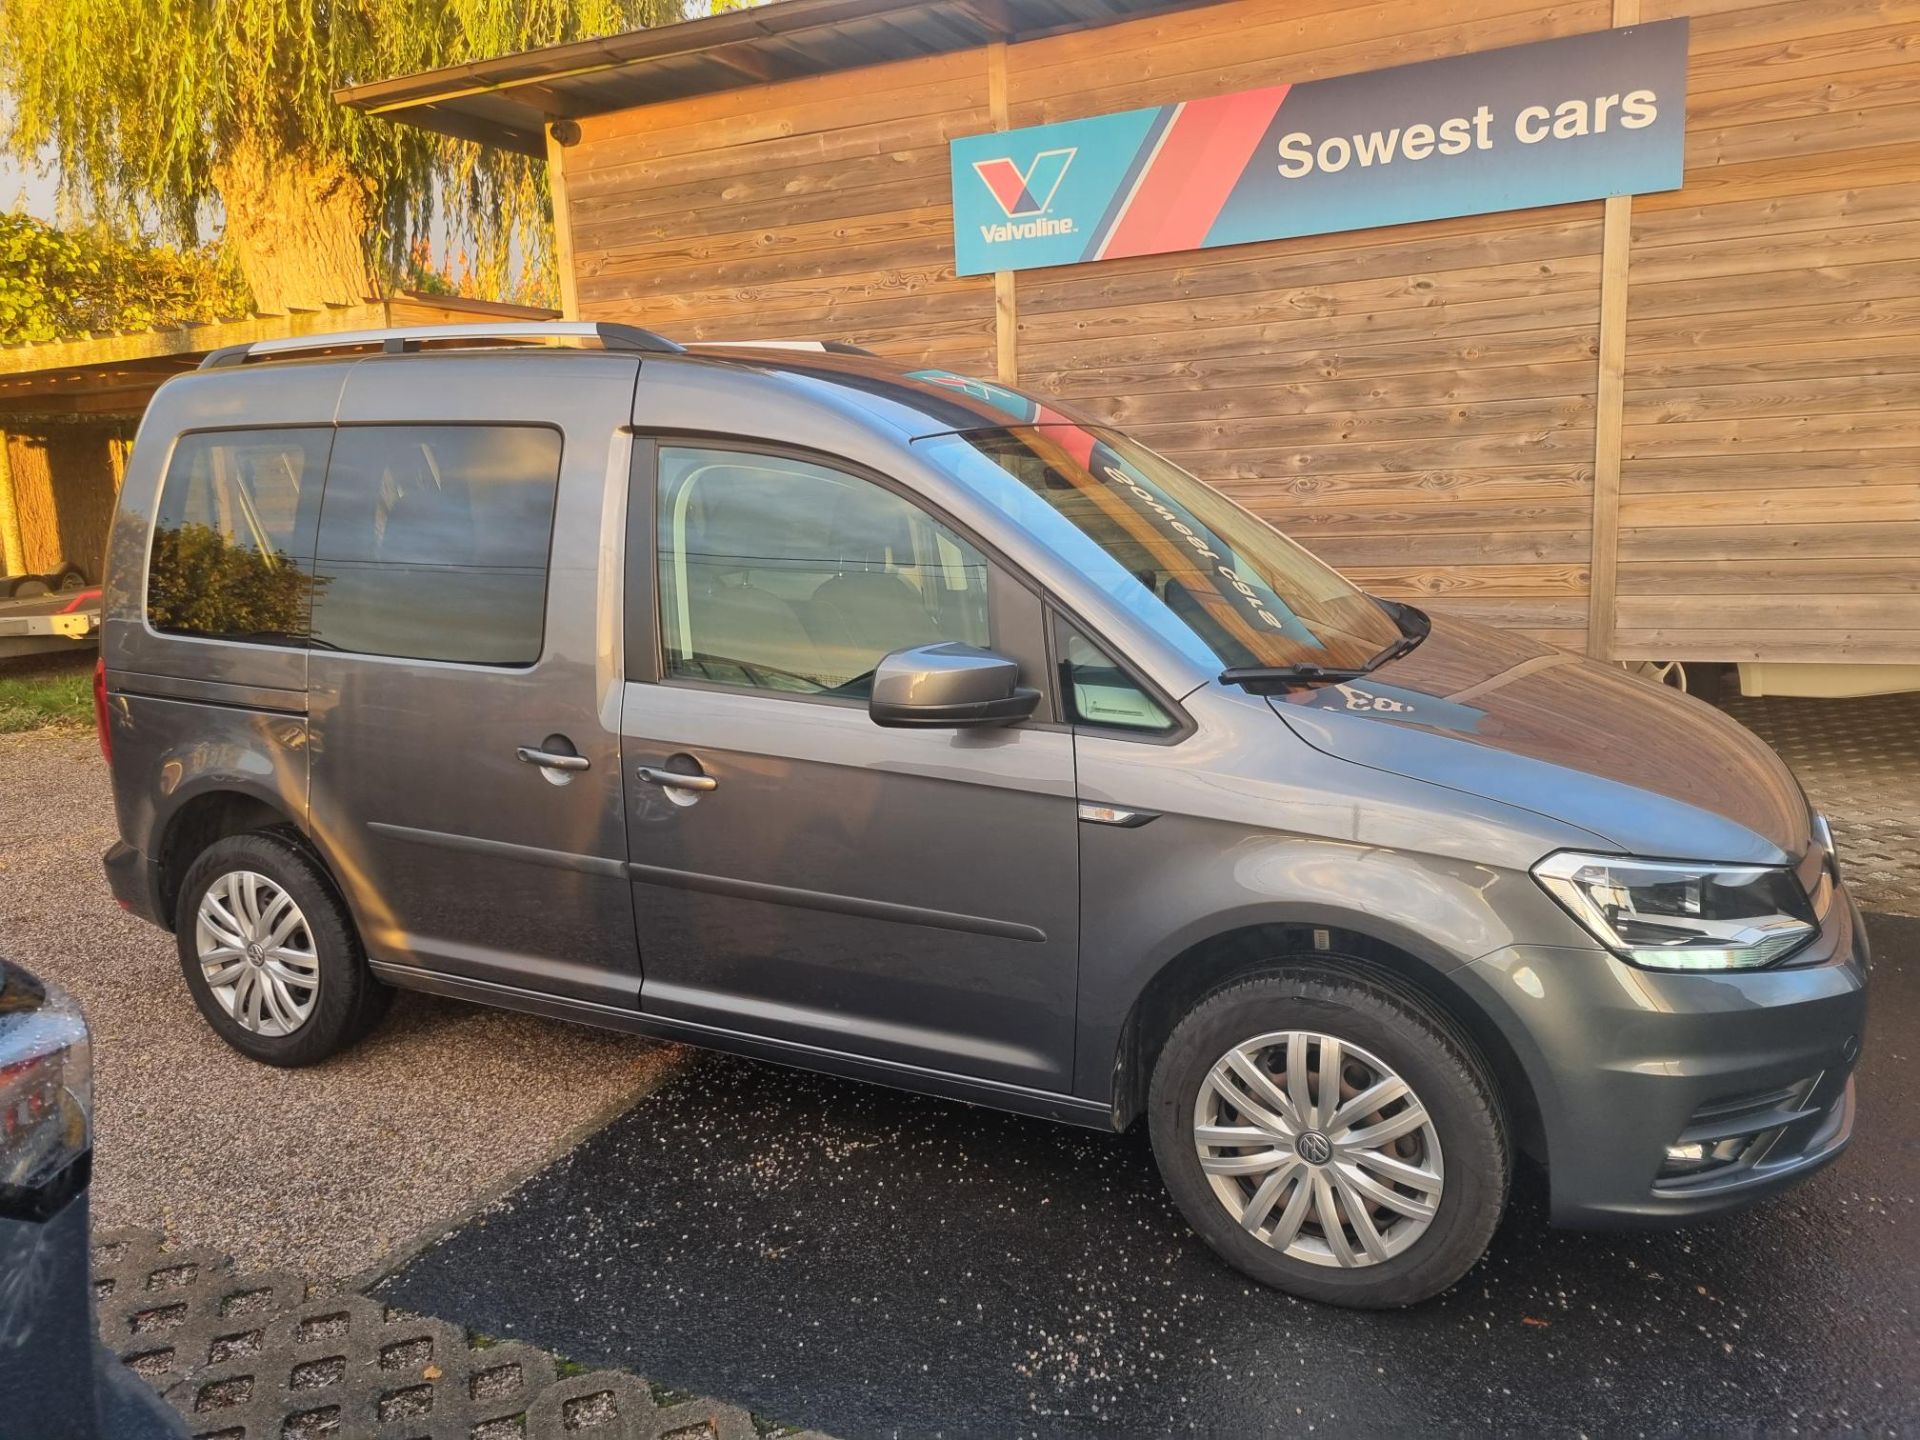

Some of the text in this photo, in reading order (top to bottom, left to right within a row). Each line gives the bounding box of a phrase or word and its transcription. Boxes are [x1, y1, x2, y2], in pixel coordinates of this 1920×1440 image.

[1277, 88, 1659, 179] Sowest cars
[979, 217, 1074, 243] Valvoline
